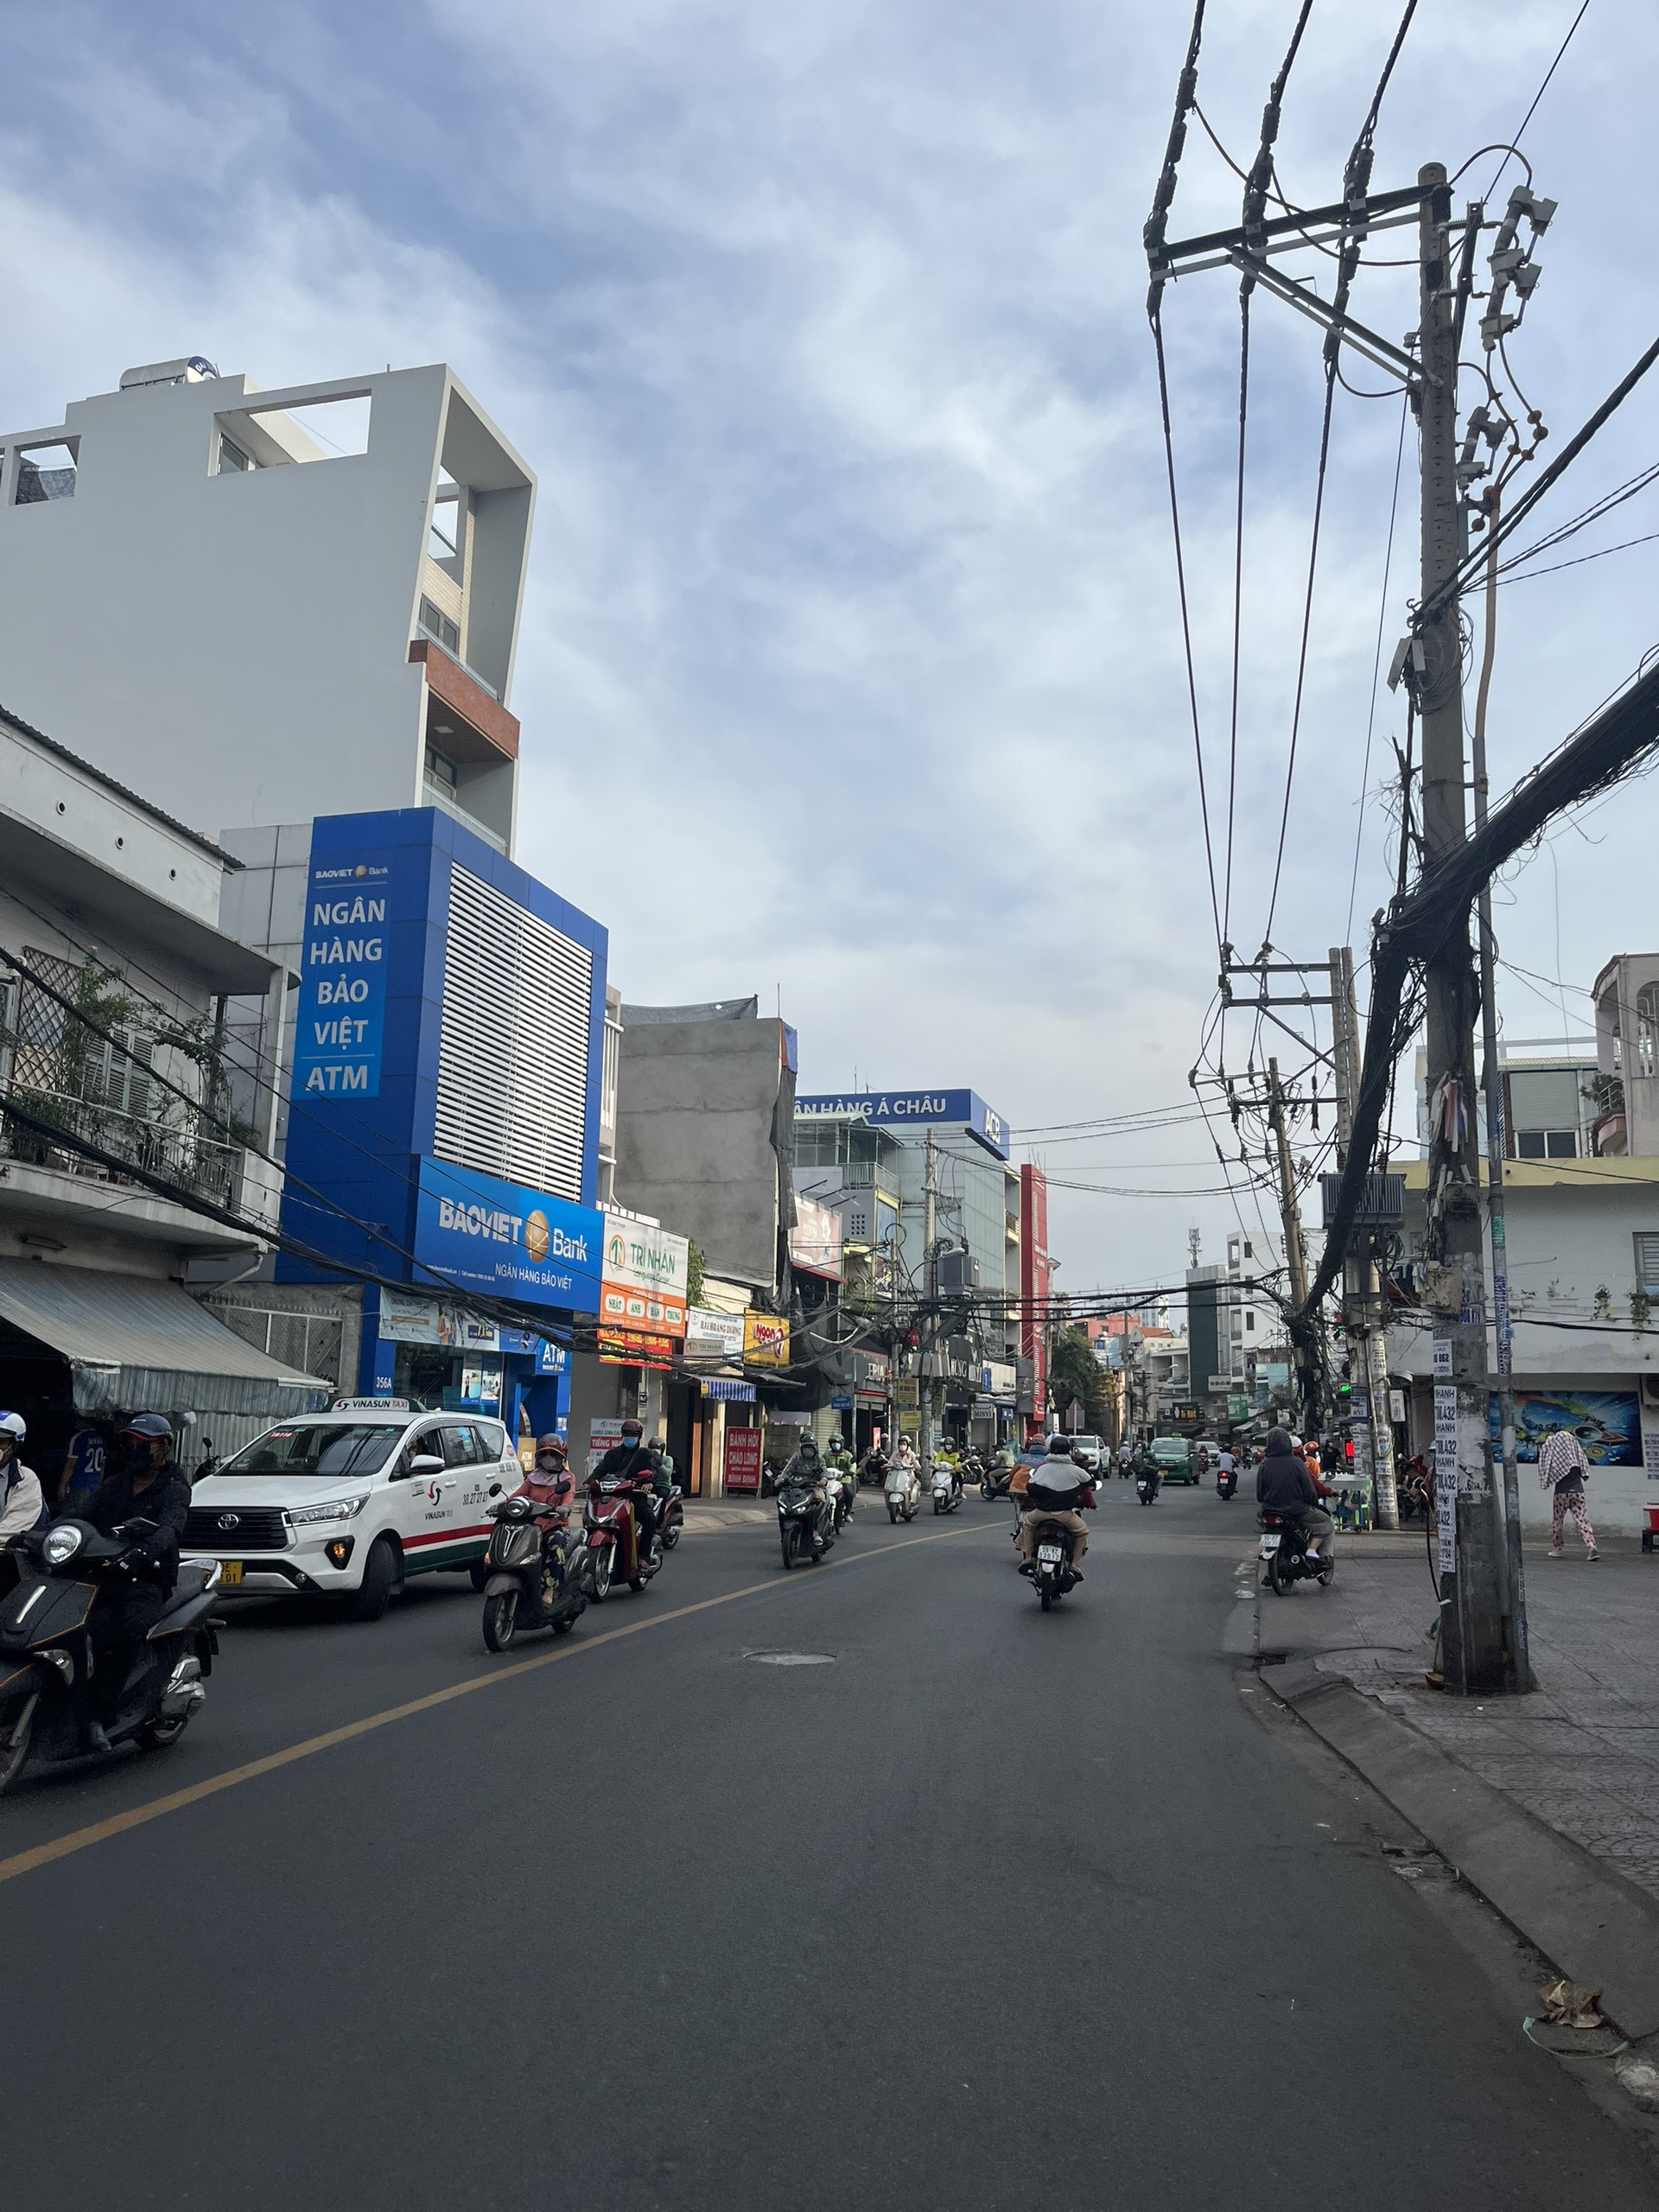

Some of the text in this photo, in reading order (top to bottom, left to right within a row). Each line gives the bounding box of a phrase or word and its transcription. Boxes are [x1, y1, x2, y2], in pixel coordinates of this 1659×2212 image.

[315, 866, 389, 879] BAOVIET Bank
[313, 896, 385, 926] NGÂN
[309, 937, 382, 965] HÀNG
[317, 974, 369, 1005] BẢO
[314, 1015, 369, 1050] VIỆT
[305, 1065, 368, 1091] ATM
[794, 1095, 946, 1116] ÂN HÀNG Á CHÂU
[984, 1109, 1001, 1145] ACB
[439, 1196, 588, 1262] BAOVIET Bank
[647, 1249, 676, 1274] NHÂN
[495, 1262, 518, 1279] NGÂN
[518, 1266, 540, 1284] HÀNG
[541, 1269, 556, 1287] BẢO
[557, 1274, 573, 1291] VIỆT
[631, 1303, 641, 1314] ANH
[543, 1344, 566, 1363] ATM
[353, 1400, 390, 1408] VINASUN
[591, 1437, 610, 1447] TIẾNG
[729, 1433, 747, 1447] BÁNH
[84, 1447, 104, 1473] 20
[425, 1511, 445, 1521] VINASUN
